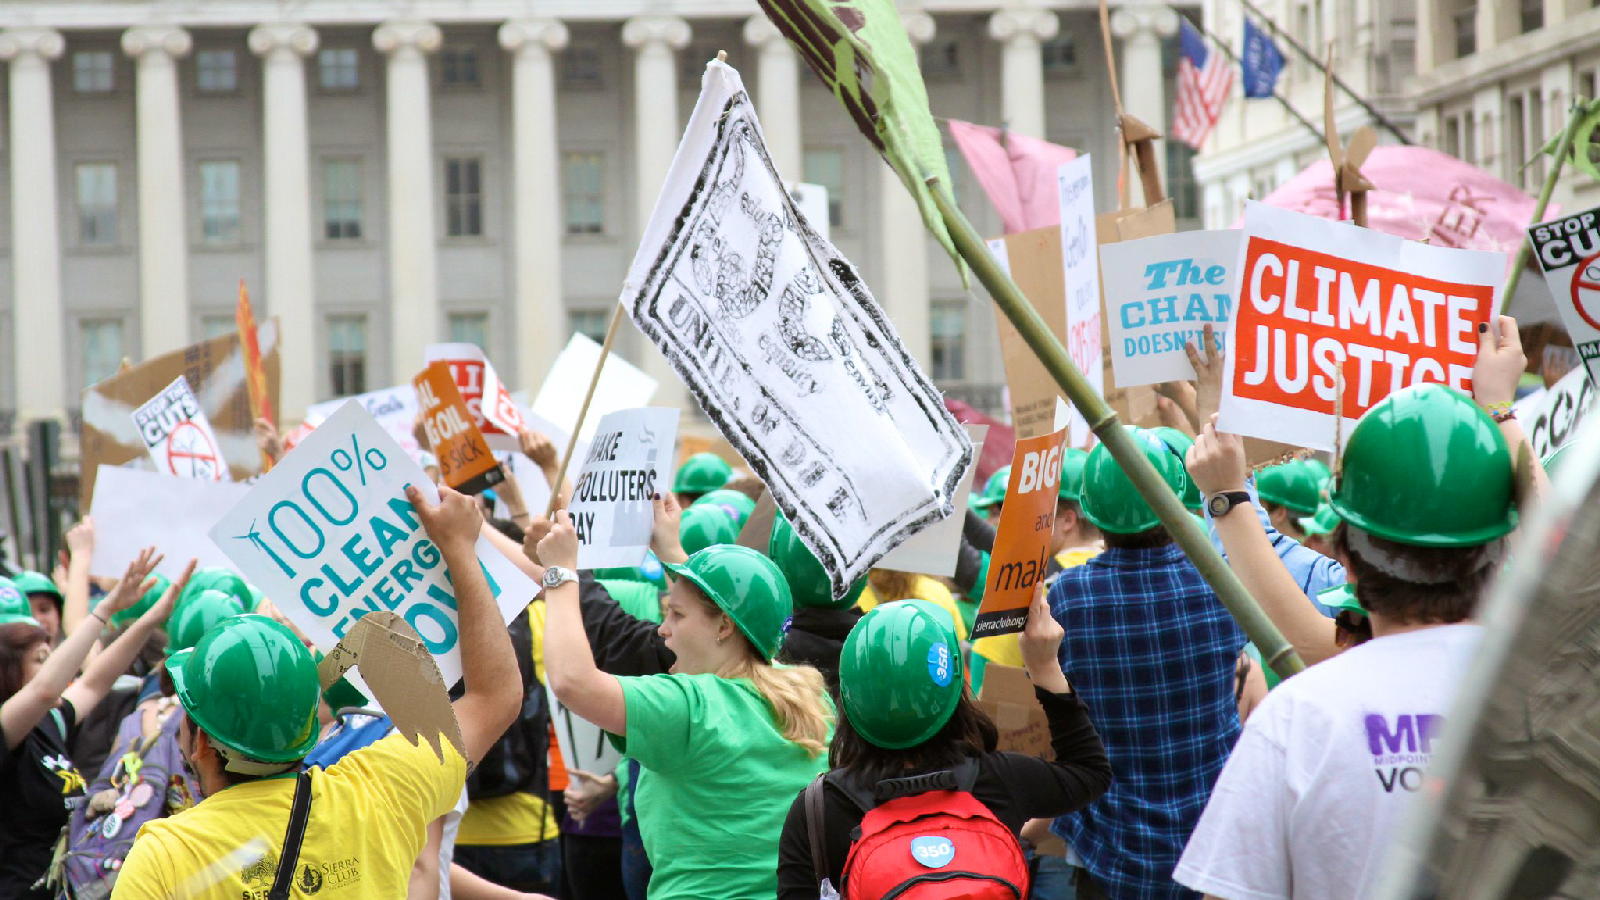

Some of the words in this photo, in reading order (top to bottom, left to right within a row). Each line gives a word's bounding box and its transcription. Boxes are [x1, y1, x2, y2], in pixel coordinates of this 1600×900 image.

[1535, 212, 1595, 243] STOP
[1143, 258, 1226, 291] The
[1120, 293, 1233, 329] CHAN
[1250, 252, 1478, 355] CLIMATE
[143, 392, 198, 444] CUTS
[436, 404, 469, 439] OIL
[586, 431, 623, 464] MAKE
[571, 469, 657, 503] POLLUTERS
[1018, 447, 1059, 494] BIG
[232, 433, 387, 580] 100%
[300, 482, 423, 618] CLEAN
[332, 538, 442, 641] ENERG
[936, 646, 949, 680] 350
[321, 856, 360, 876] SIERRA
[915, 842, 951, 859] 350
[327, 867, 360, 886] CLUB
